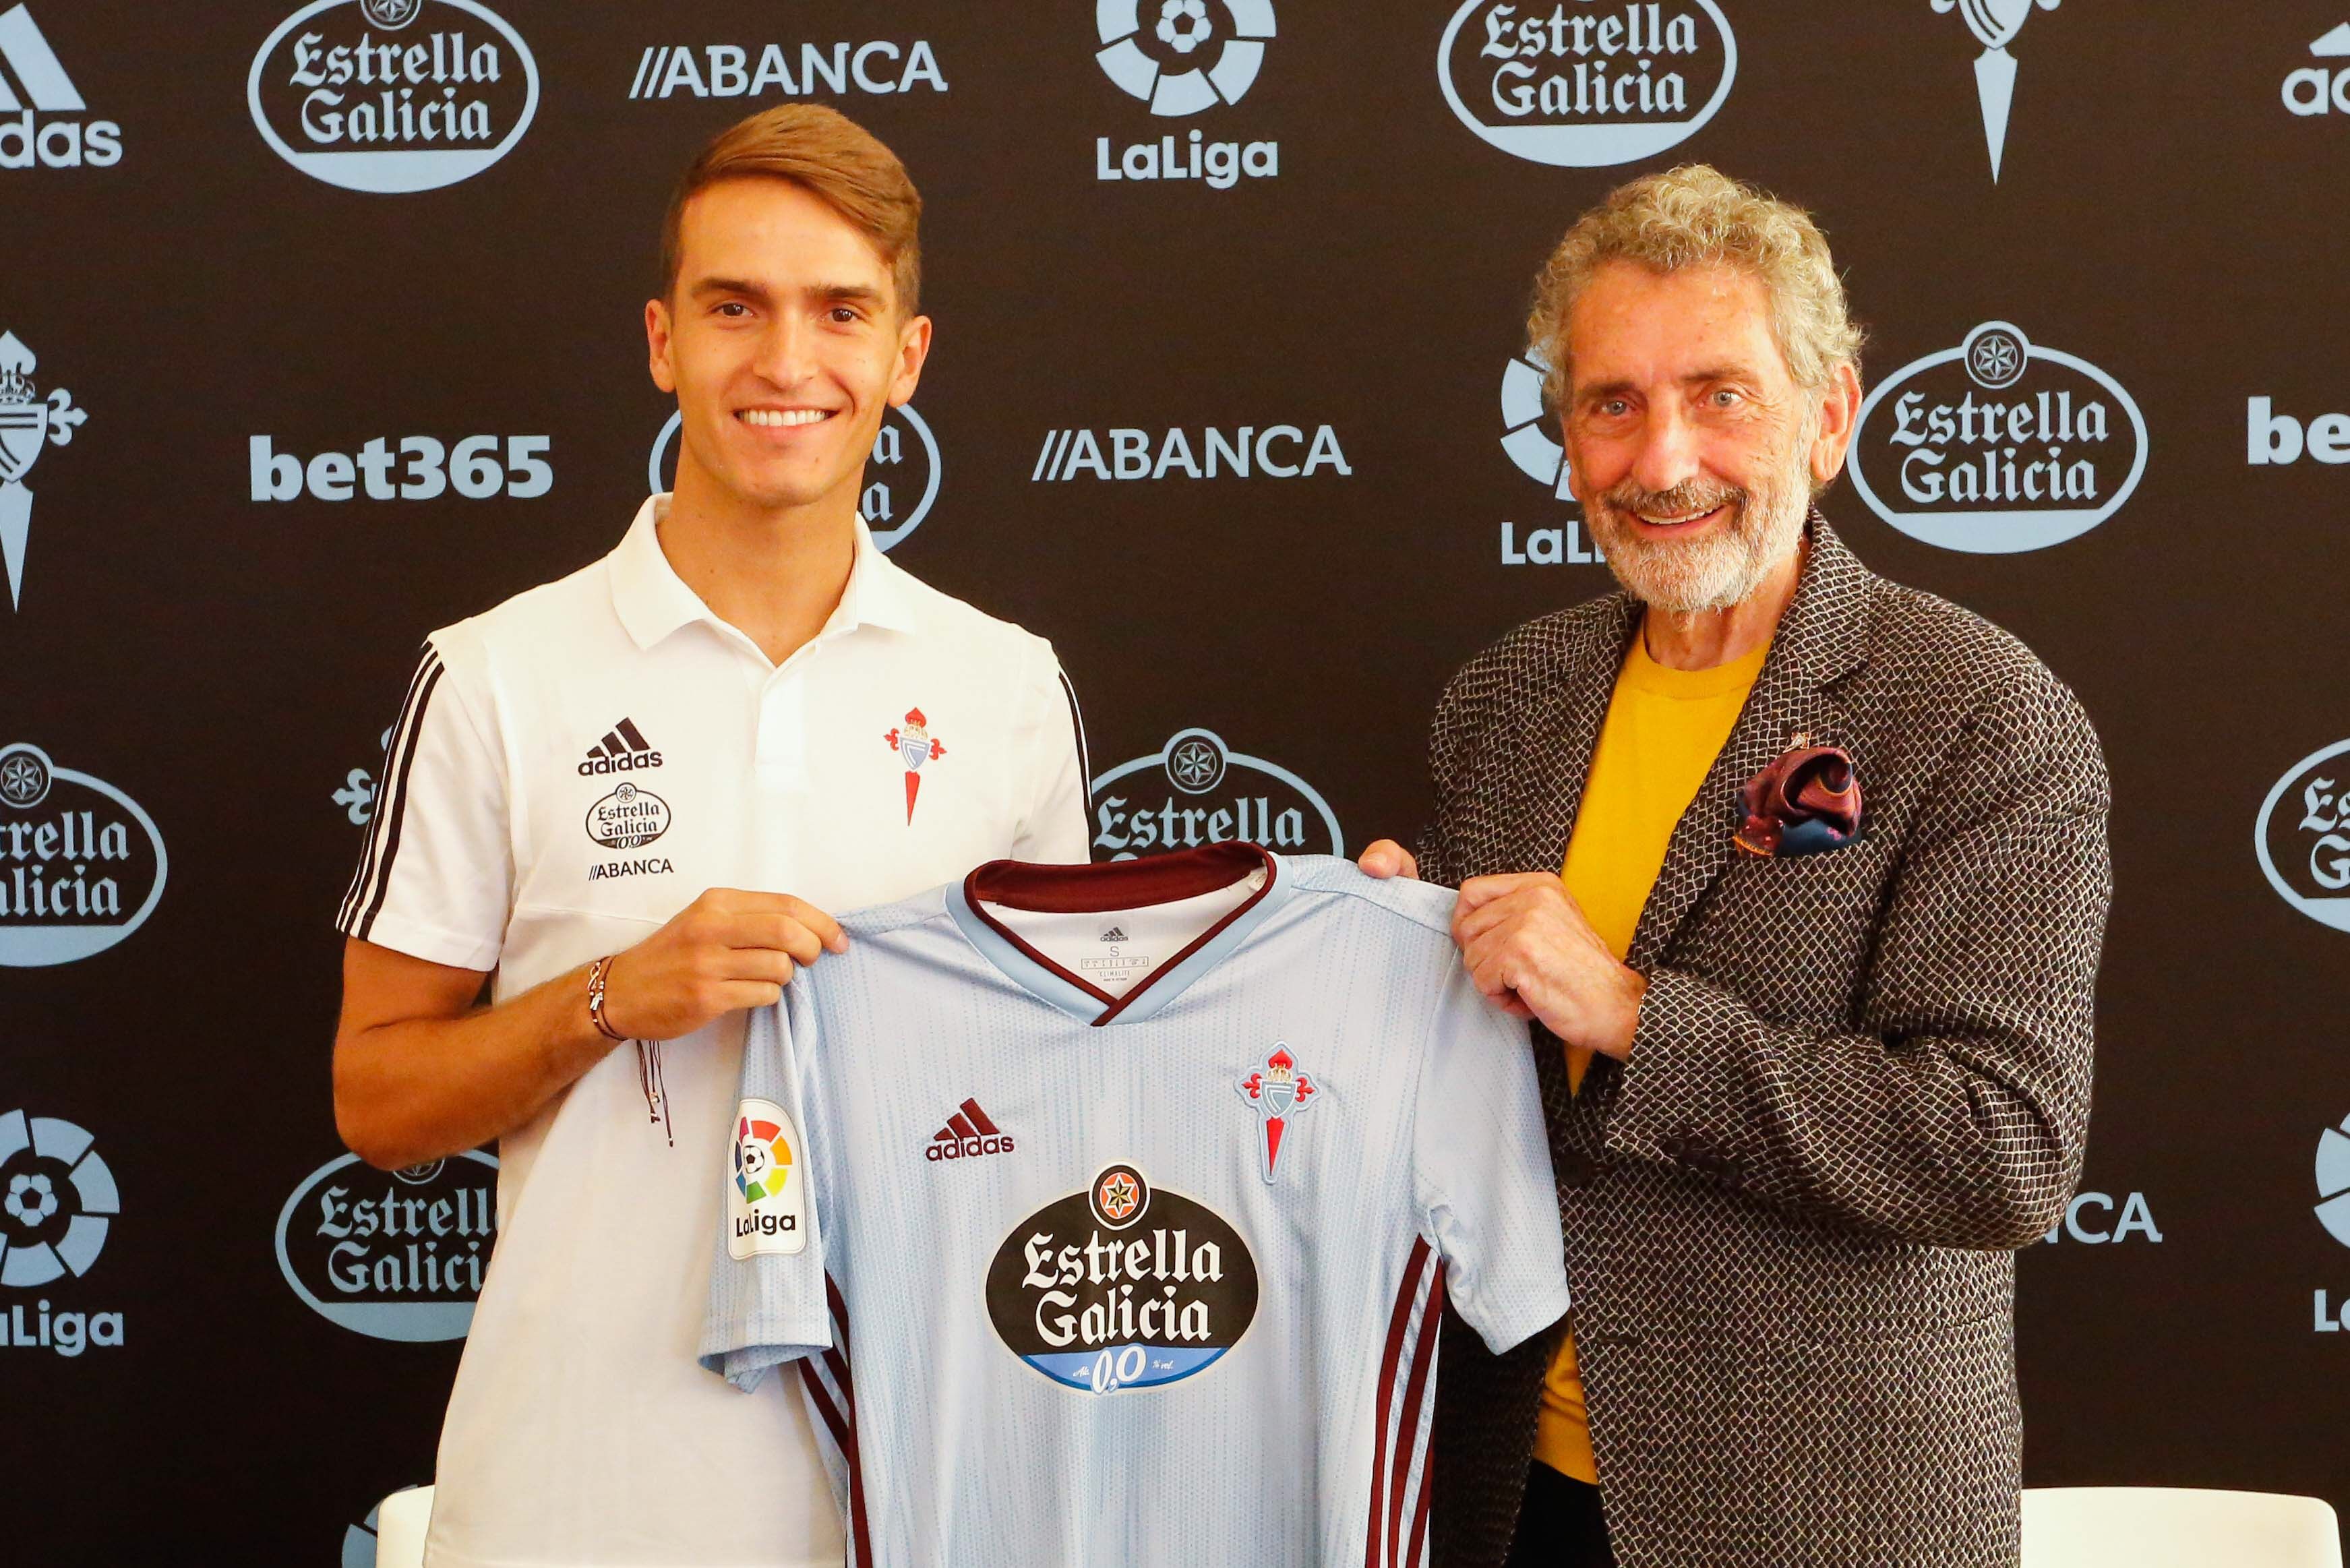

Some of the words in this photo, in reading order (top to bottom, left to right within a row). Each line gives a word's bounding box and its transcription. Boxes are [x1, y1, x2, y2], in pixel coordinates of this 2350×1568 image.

[1480, 3, 1698, 59] Estrella
[290, 32, 501, 87] Estrella
[1491, 59, 1687, 117] Galicia
[301, 88, 492, 144] Galicia
[1097, 129, 1278, 189] LaLiga
[1889, 391, 2109, 446] Estrella
[249, 435, 553, 502] bet365
[1900, 446, 2097, 504] Galicia
[578, 751, 663, 776] adidas
[597, 802, 659, 821] Estrella
[600, 818, 658, 837] Galicia
[1093, 796, 1306, 848] Estrella
[1110, 946, 1120, 957] S
[926, 1135, 1015, 1162] adidas
[316, 1186, 500, 1238] Estrell
[735, 1209, 795, 1238] LaLiga
[328, 1241, 491, 1293] Galici
[1022, 1229, 1224, 1289] Estrella
[1035, 1284, 1212, 1348] Galicia
